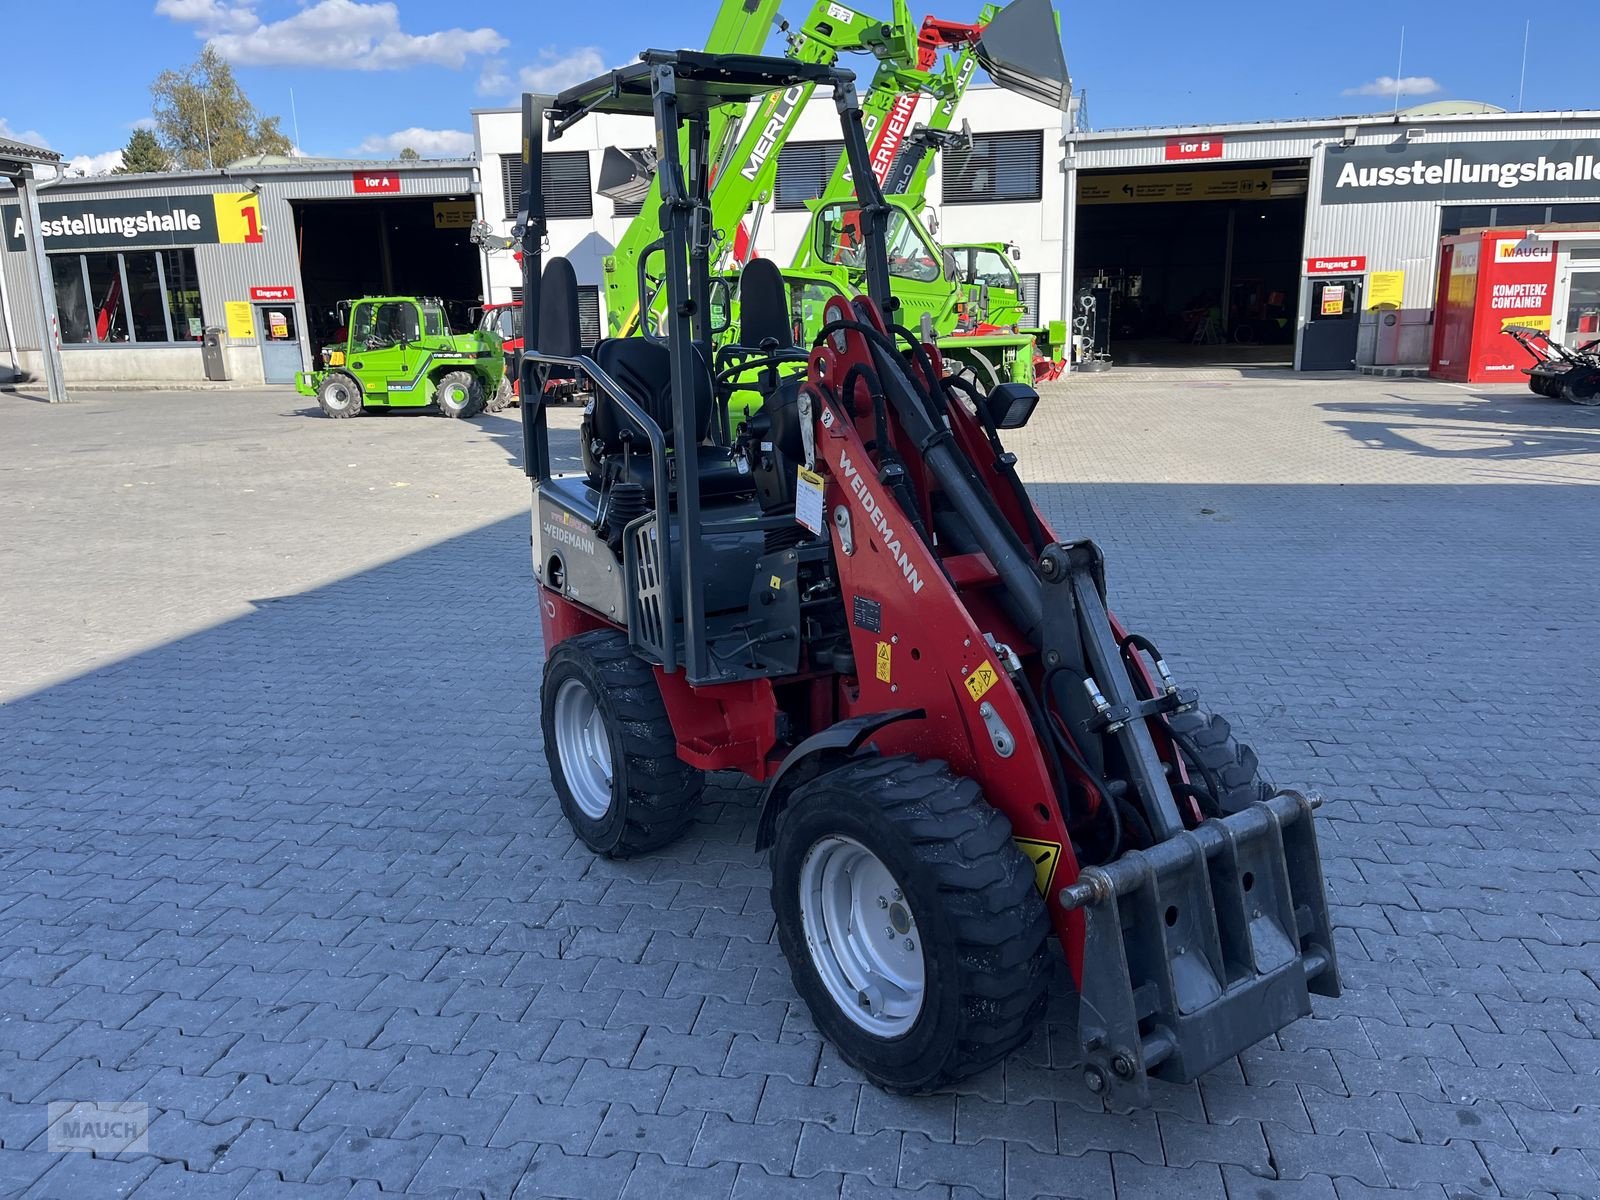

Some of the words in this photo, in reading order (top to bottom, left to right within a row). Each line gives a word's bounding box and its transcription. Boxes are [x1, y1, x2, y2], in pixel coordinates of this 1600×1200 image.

[942, 59, 974, 115] MRLO
[740, 85, 804, 181] MERLO
[871, 94, 914, 184] ERWEHR
[1178, 142, 1199, 153] Tor
[1201, 141, 1210, 151] B
[363, 177, 380, 187] Tor
[381, 176, 390, 187] A
[893, 164, 913, 195] RLO
[13, 208, 201, 238] Asstellungshalle
[241, 206, 263, 243] 1
[1503, 247, 1548, 258] MAUCH
[1315, 261, 1349, 270] Eingang
[1350, 259, 1358, 267] B
[256, 290, 282, 298] Eingang
[283, 289, 288, 297] A
[1492, 284, 1548, 297] KOMPETENZ
[1492, 297, 1541, 309] CONTAINER
[839, 449, 924, 594] WEIDEMANN
